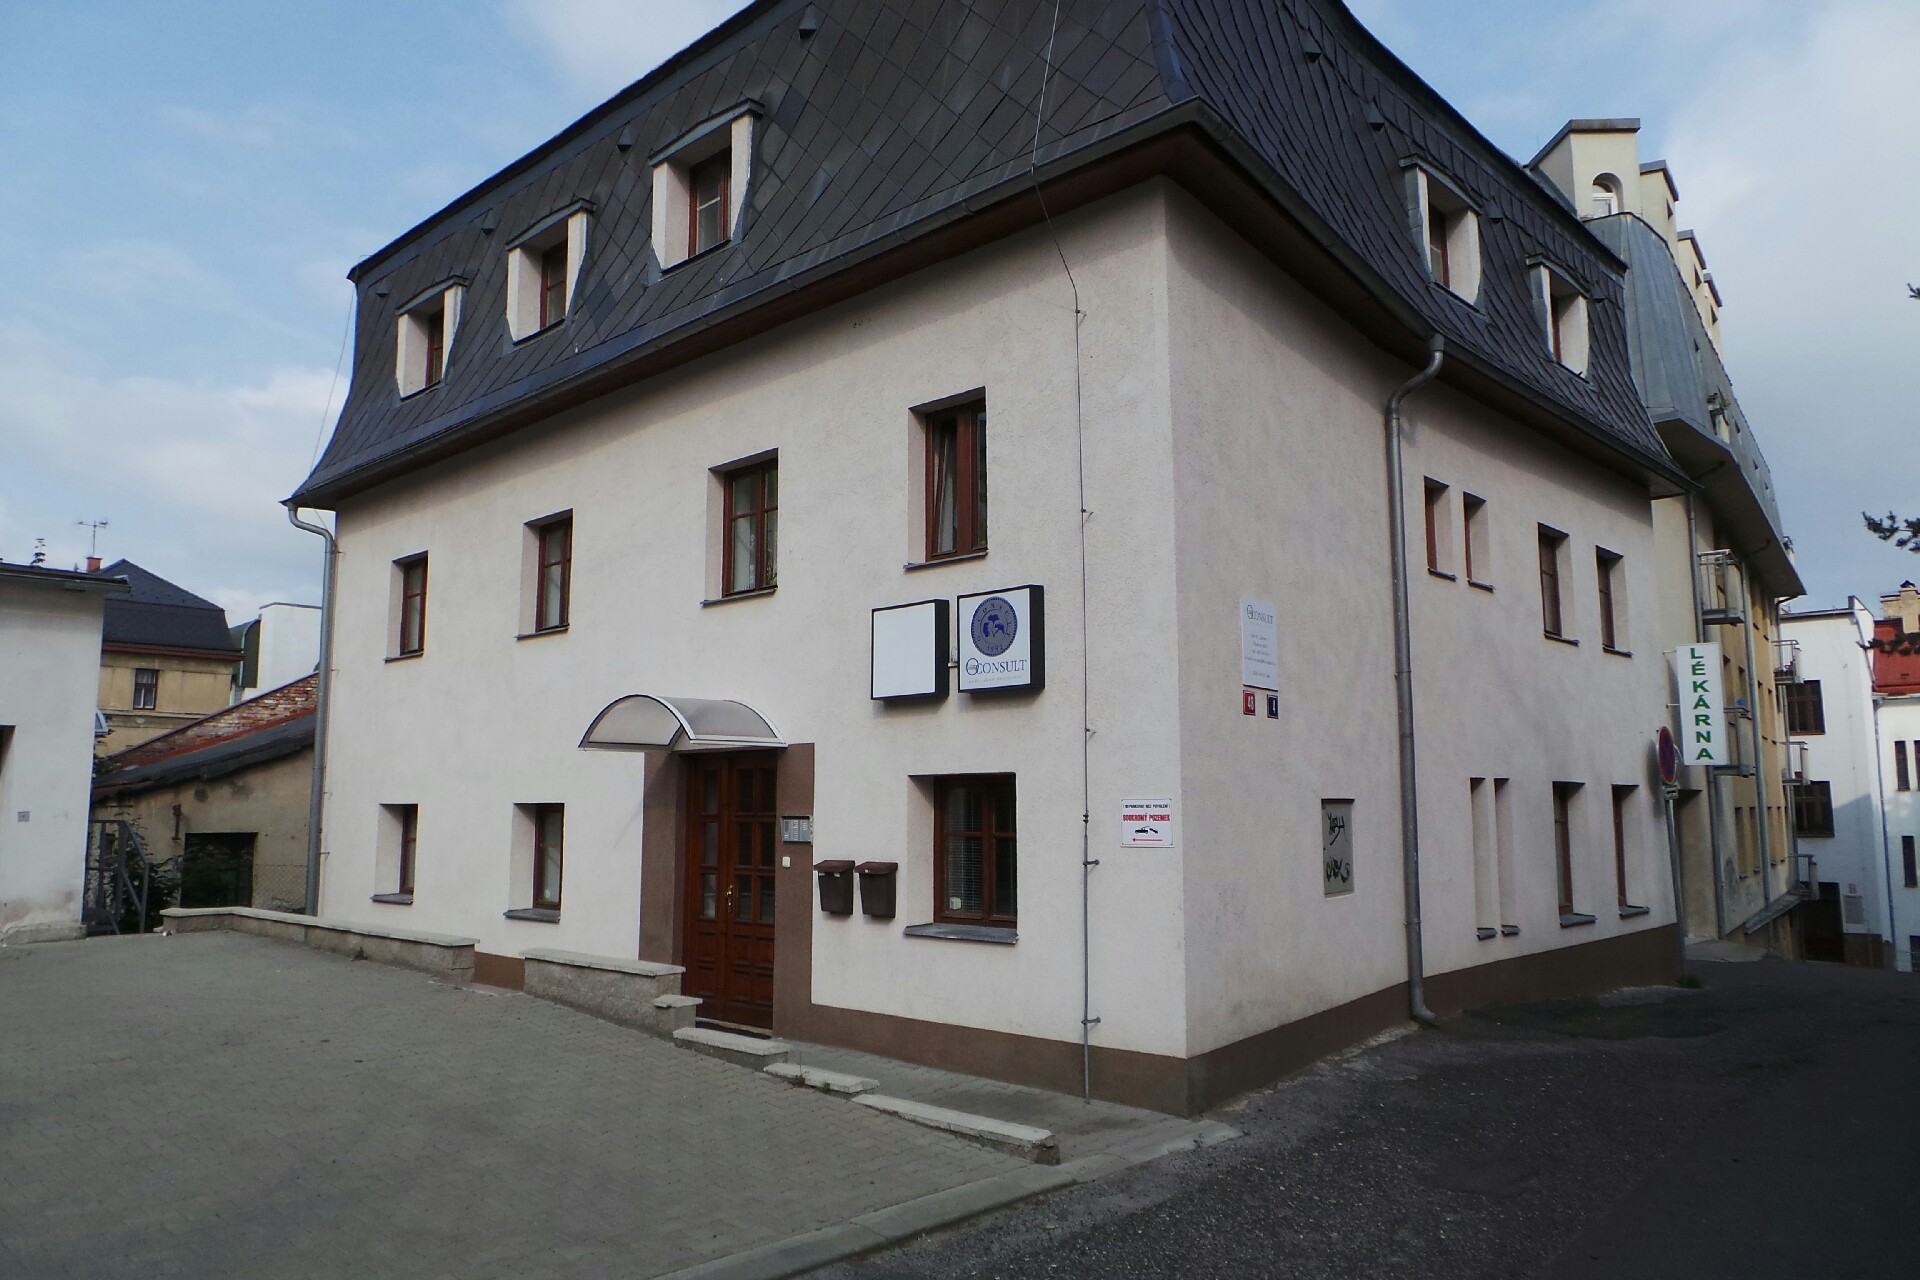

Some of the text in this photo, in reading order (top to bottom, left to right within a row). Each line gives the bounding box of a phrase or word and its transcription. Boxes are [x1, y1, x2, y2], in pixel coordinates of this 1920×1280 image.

[1690, 647, 1714, 761] LÉKÁRNA
[1123, 812, 1171, 822] SOUKROMÝ POZEMEK
